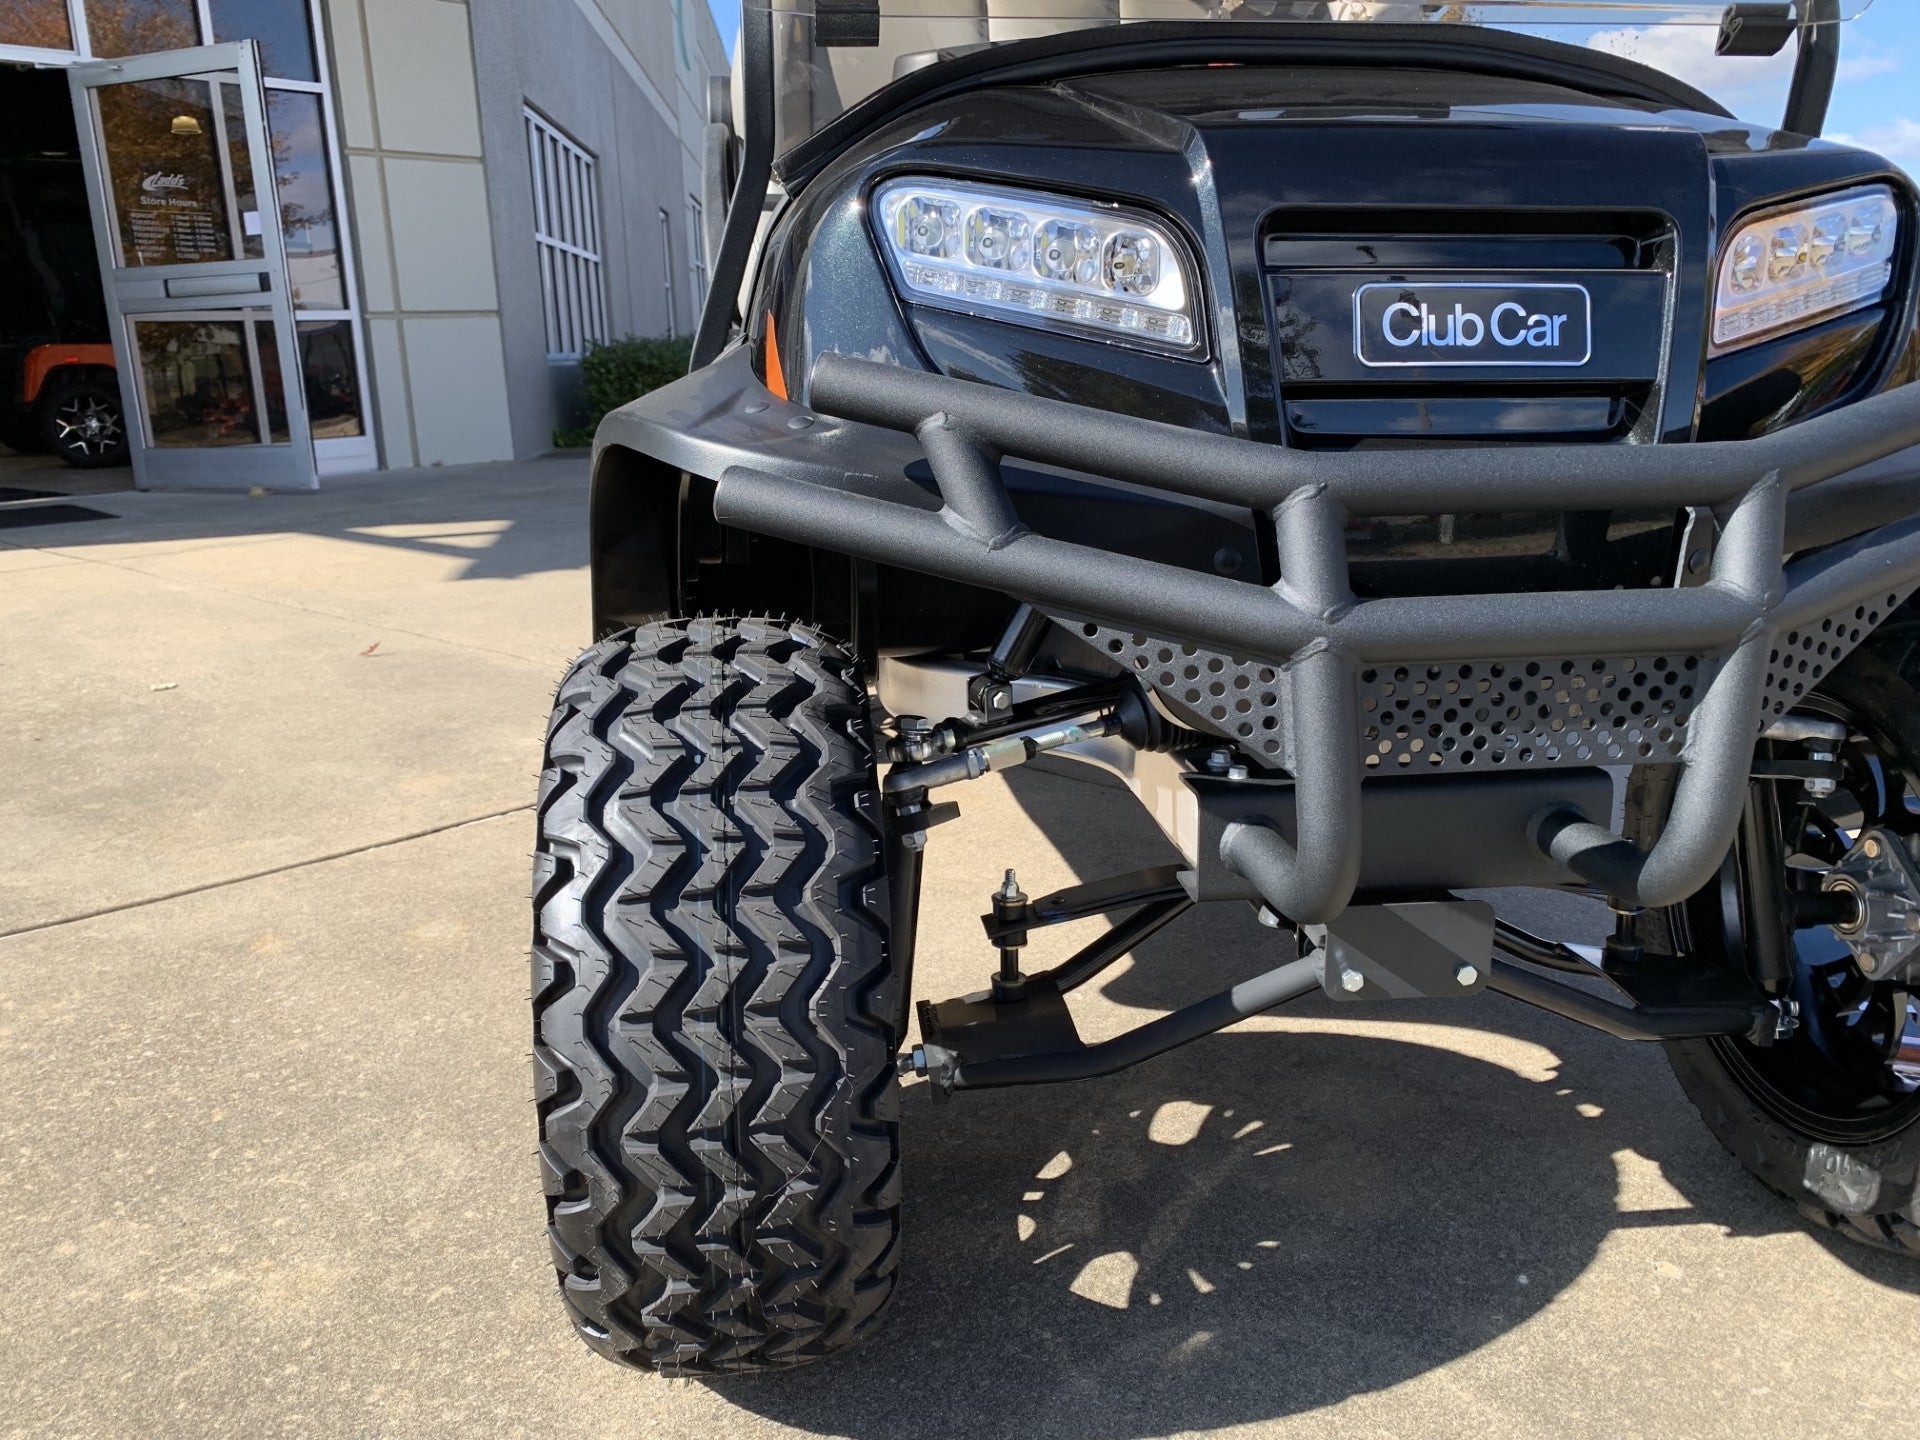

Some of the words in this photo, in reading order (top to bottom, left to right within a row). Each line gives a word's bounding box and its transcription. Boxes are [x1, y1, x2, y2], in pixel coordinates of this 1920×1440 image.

[140, 196, 167, 206] Store
[168, 198, 198, 208] Hours
[1382, 302, 1485, 347] Club
[1490, 302, 1567, 347] Car
